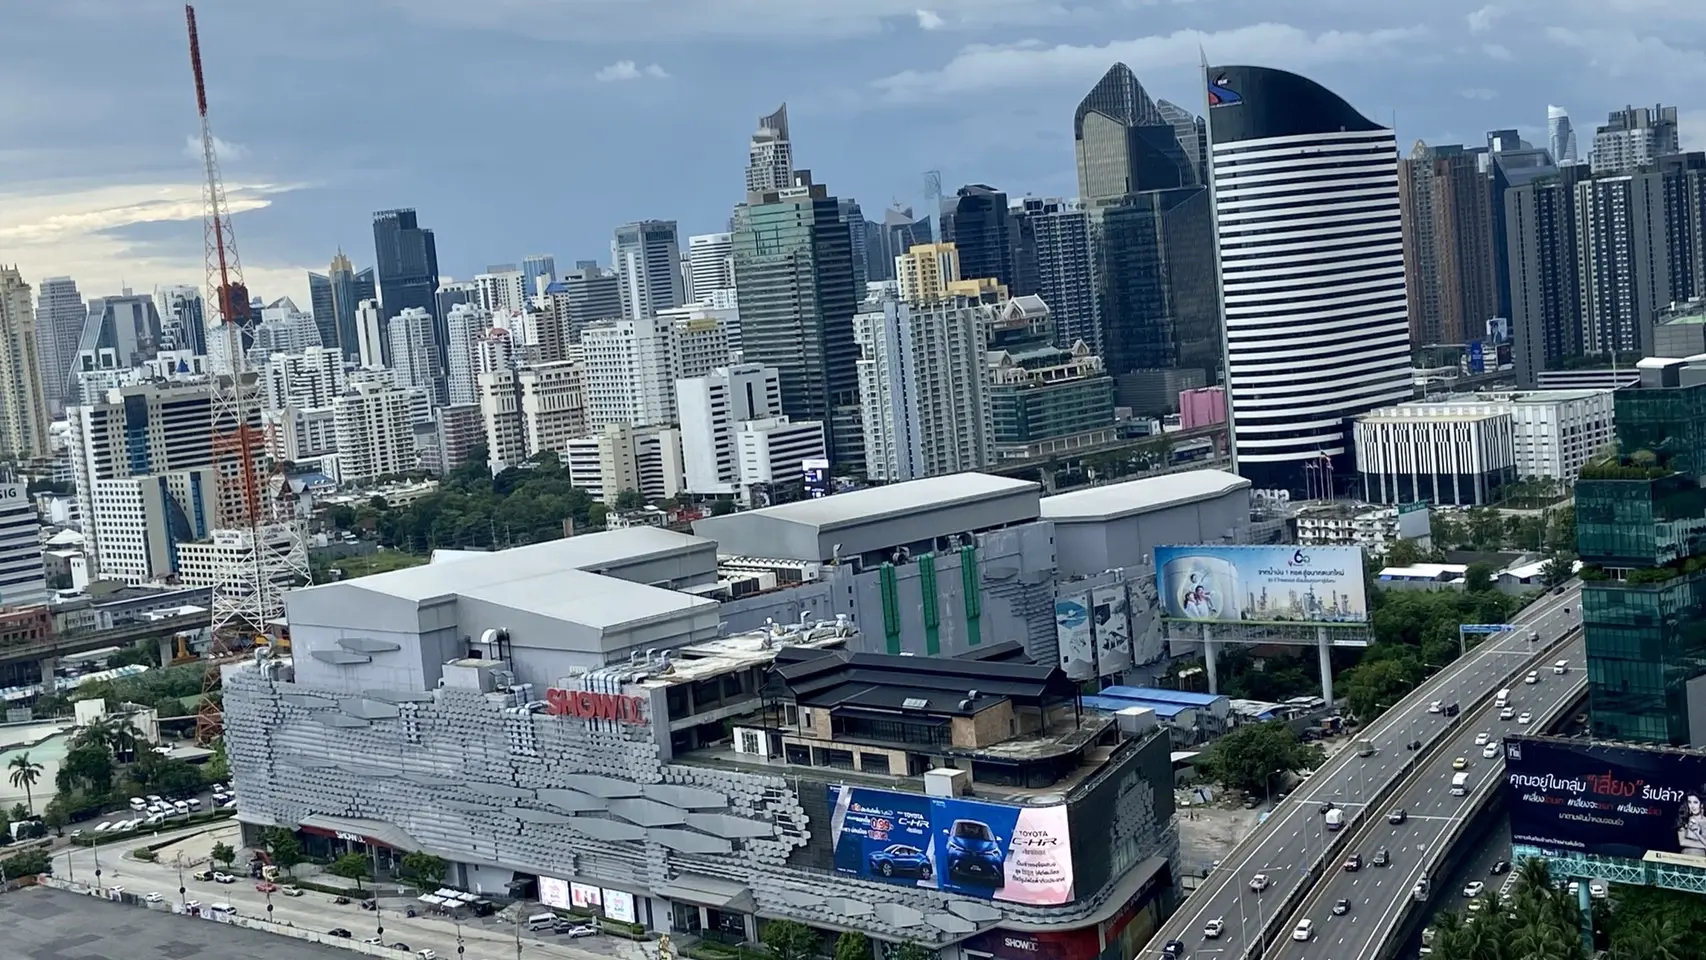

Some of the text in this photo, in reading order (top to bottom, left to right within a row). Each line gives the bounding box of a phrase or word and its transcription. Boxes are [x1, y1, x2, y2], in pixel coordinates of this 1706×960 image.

[1509, 773, 1587, 796] คุณอยู่ในกลุ่ม
[898, 817, 930, 828] C-HR
[1019, 830, 1048, 838] TOYOTA
[1012, 837, 1058, 846] C-HR
